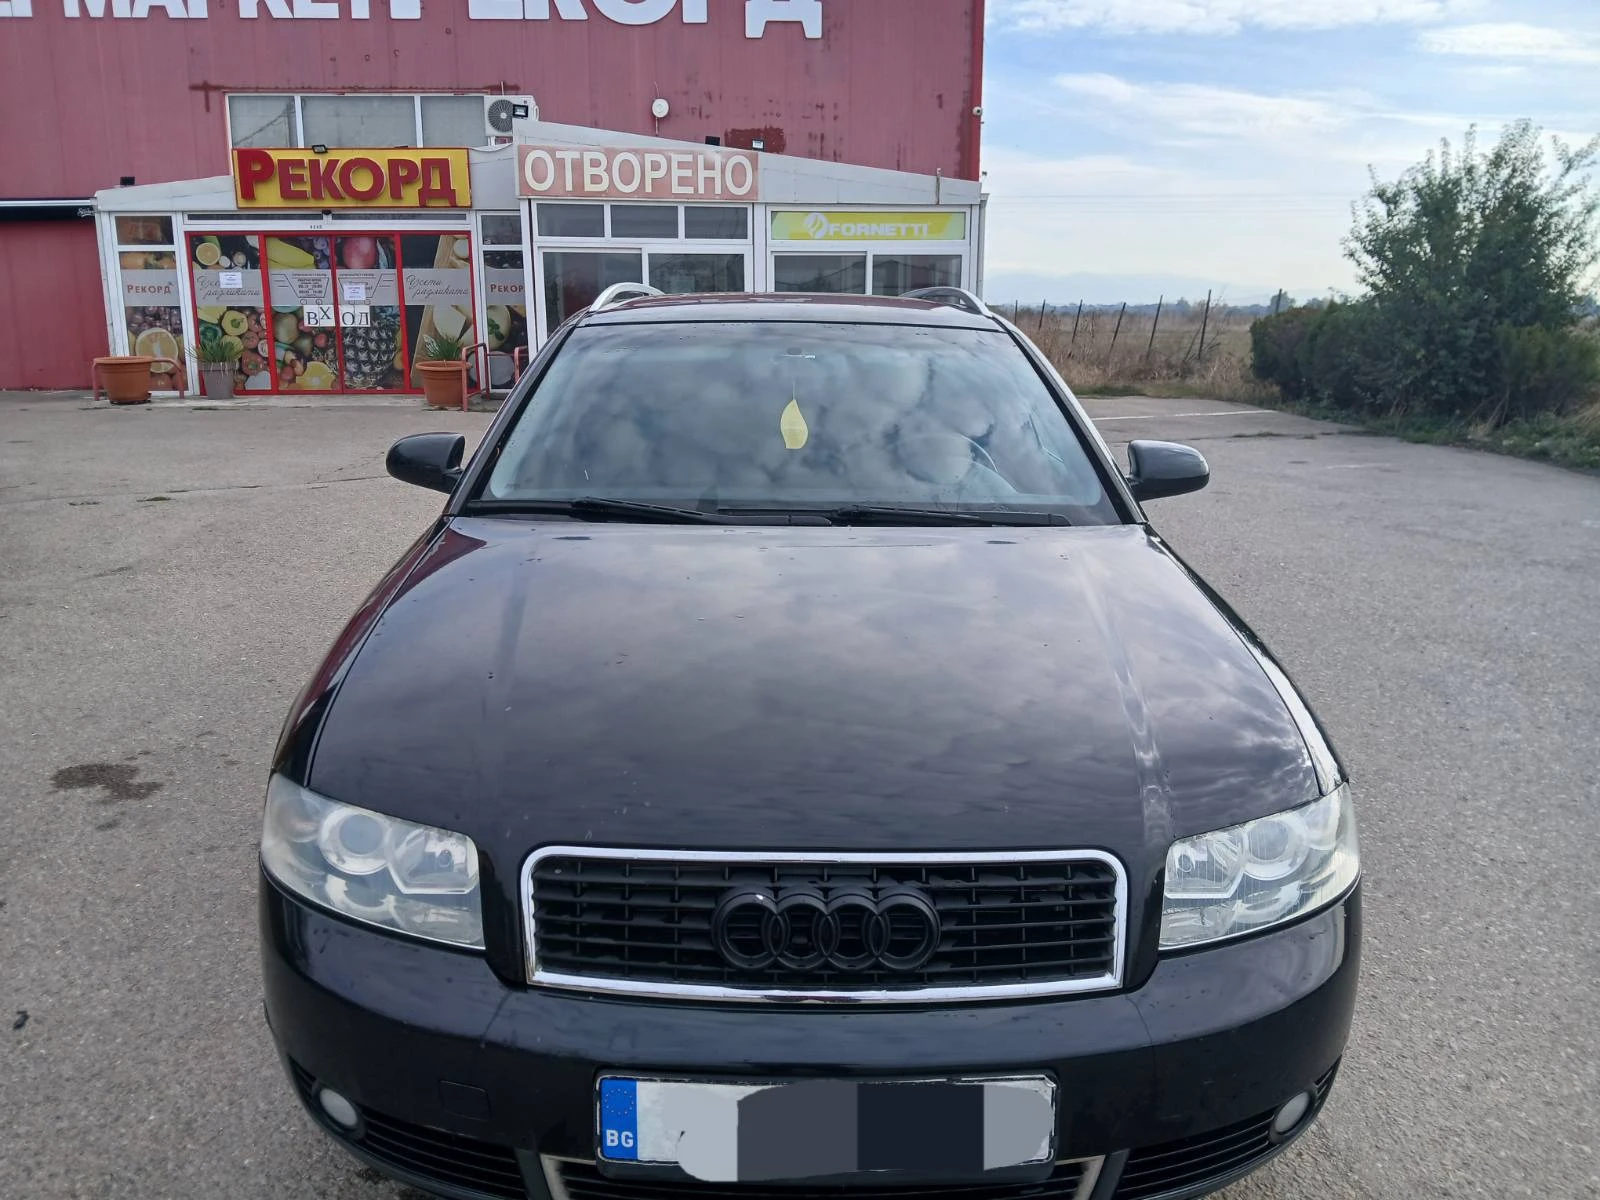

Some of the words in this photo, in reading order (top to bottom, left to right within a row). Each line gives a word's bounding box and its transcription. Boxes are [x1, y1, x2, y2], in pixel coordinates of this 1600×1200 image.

[524, 149, 753, 196] ОТВОРЕНО
[828, 223, 929, 237] FORNETTI
[490, 283, 524, 293] РЕКОР
[606, 1129, 634, 1148] BG
